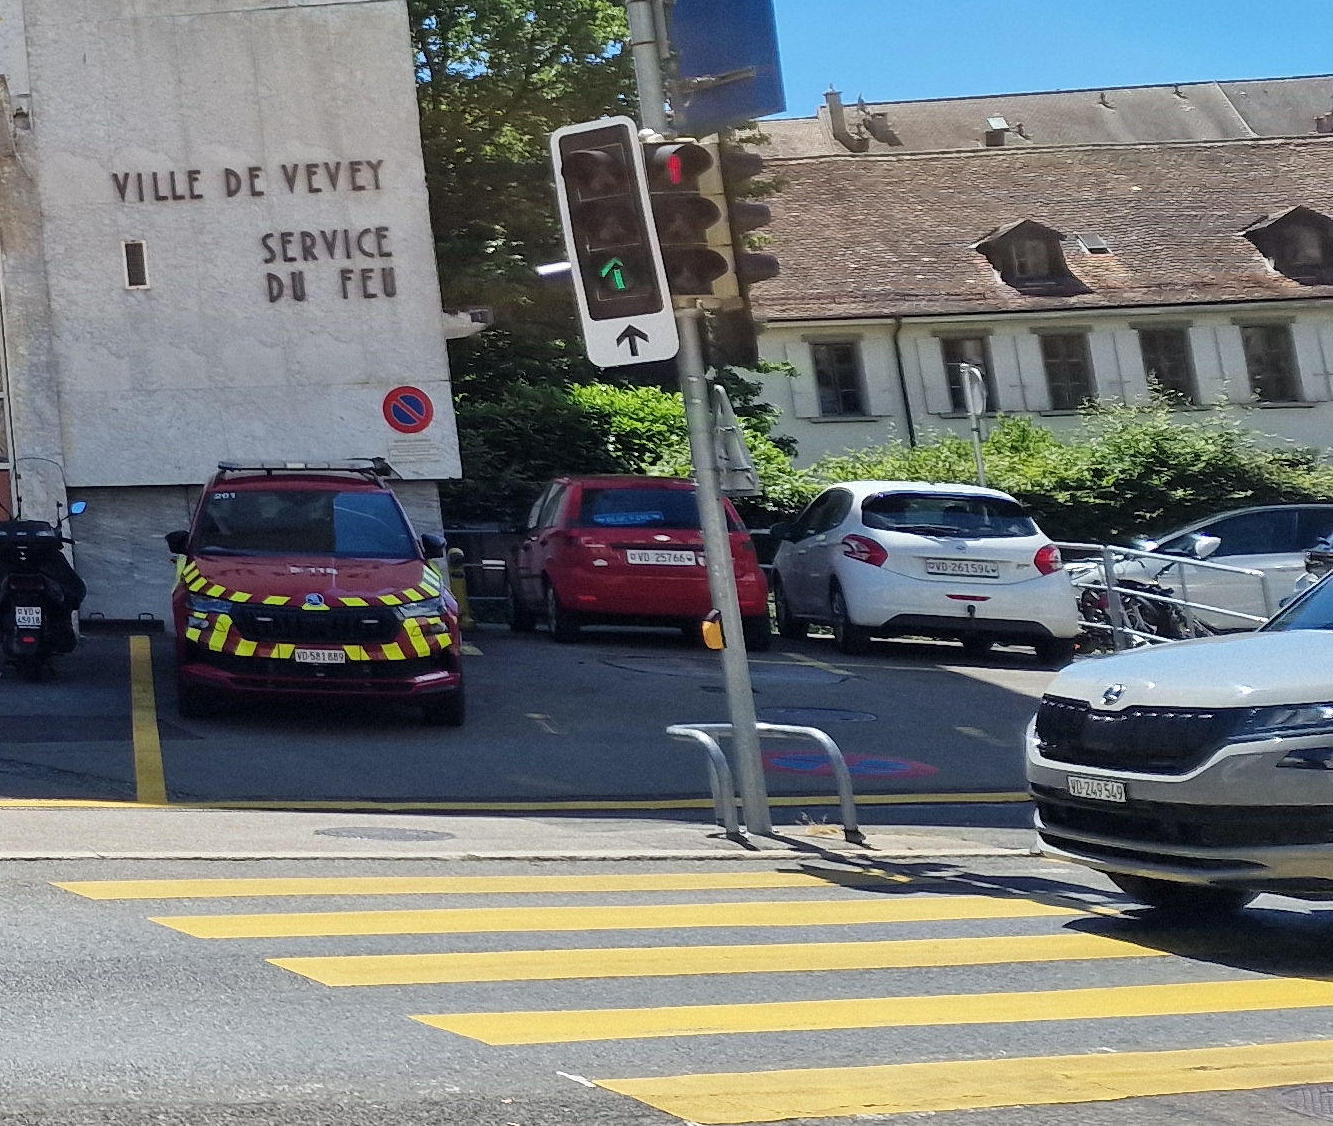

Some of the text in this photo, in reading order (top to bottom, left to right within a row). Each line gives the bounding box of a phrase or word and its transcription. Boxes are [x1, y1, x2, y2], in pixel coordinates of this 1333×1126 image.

[112, 159, 384, 202] VILLE DE VEVEY
[261, 226, 393, 264] SERVICE
[267, 267, 397, 303] DU FEU
[213, 492, 236, 500] 201
